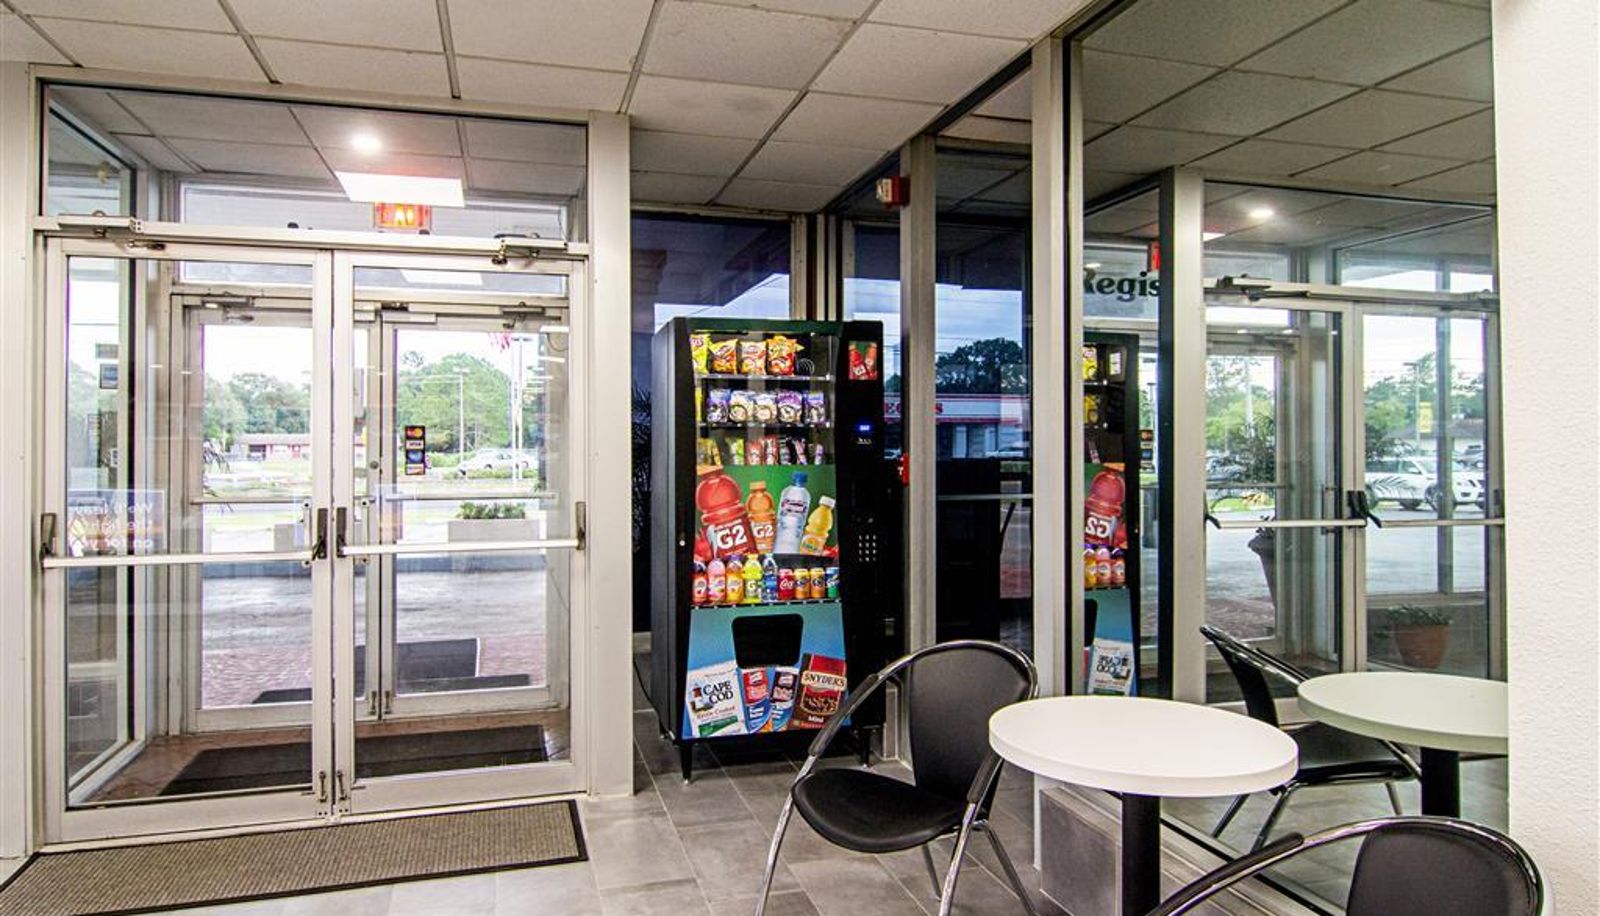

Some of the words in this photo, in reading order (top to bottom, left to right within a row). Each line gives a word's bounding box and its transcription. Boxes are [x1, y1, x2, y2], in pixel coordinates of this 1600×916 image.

[716, 524, 747, 550] G2
[753, 524, 774, 538] G2
[703, 680, 733, 696] CAPE
[708, 690, 734, 704] COD
